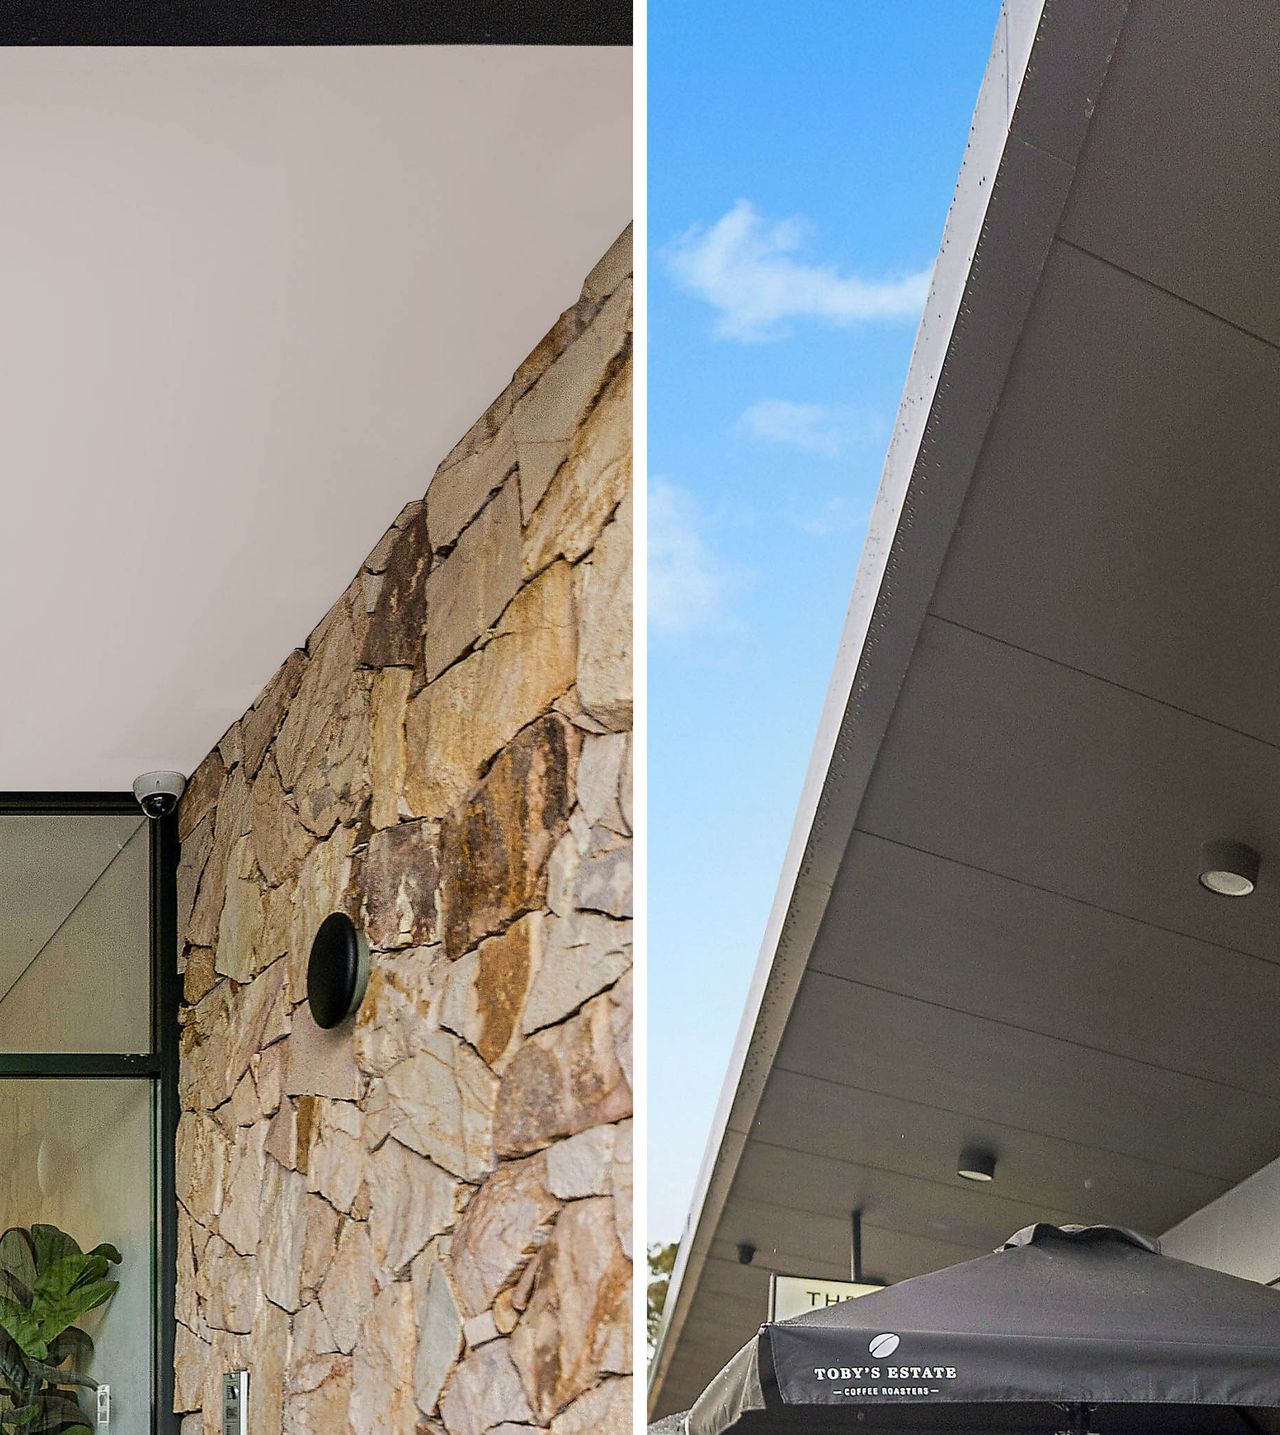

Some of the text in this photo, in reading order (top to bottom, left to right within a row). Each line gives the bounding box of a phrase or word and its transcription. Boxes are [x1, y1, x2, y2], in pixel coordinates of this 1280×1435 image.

[806, 1291, 857, 1306] TH
[814, 1366, 957, 1380] TOBY'S ESTATE
[844, 1387, 929, 1396] COFFEE ROASTERS
